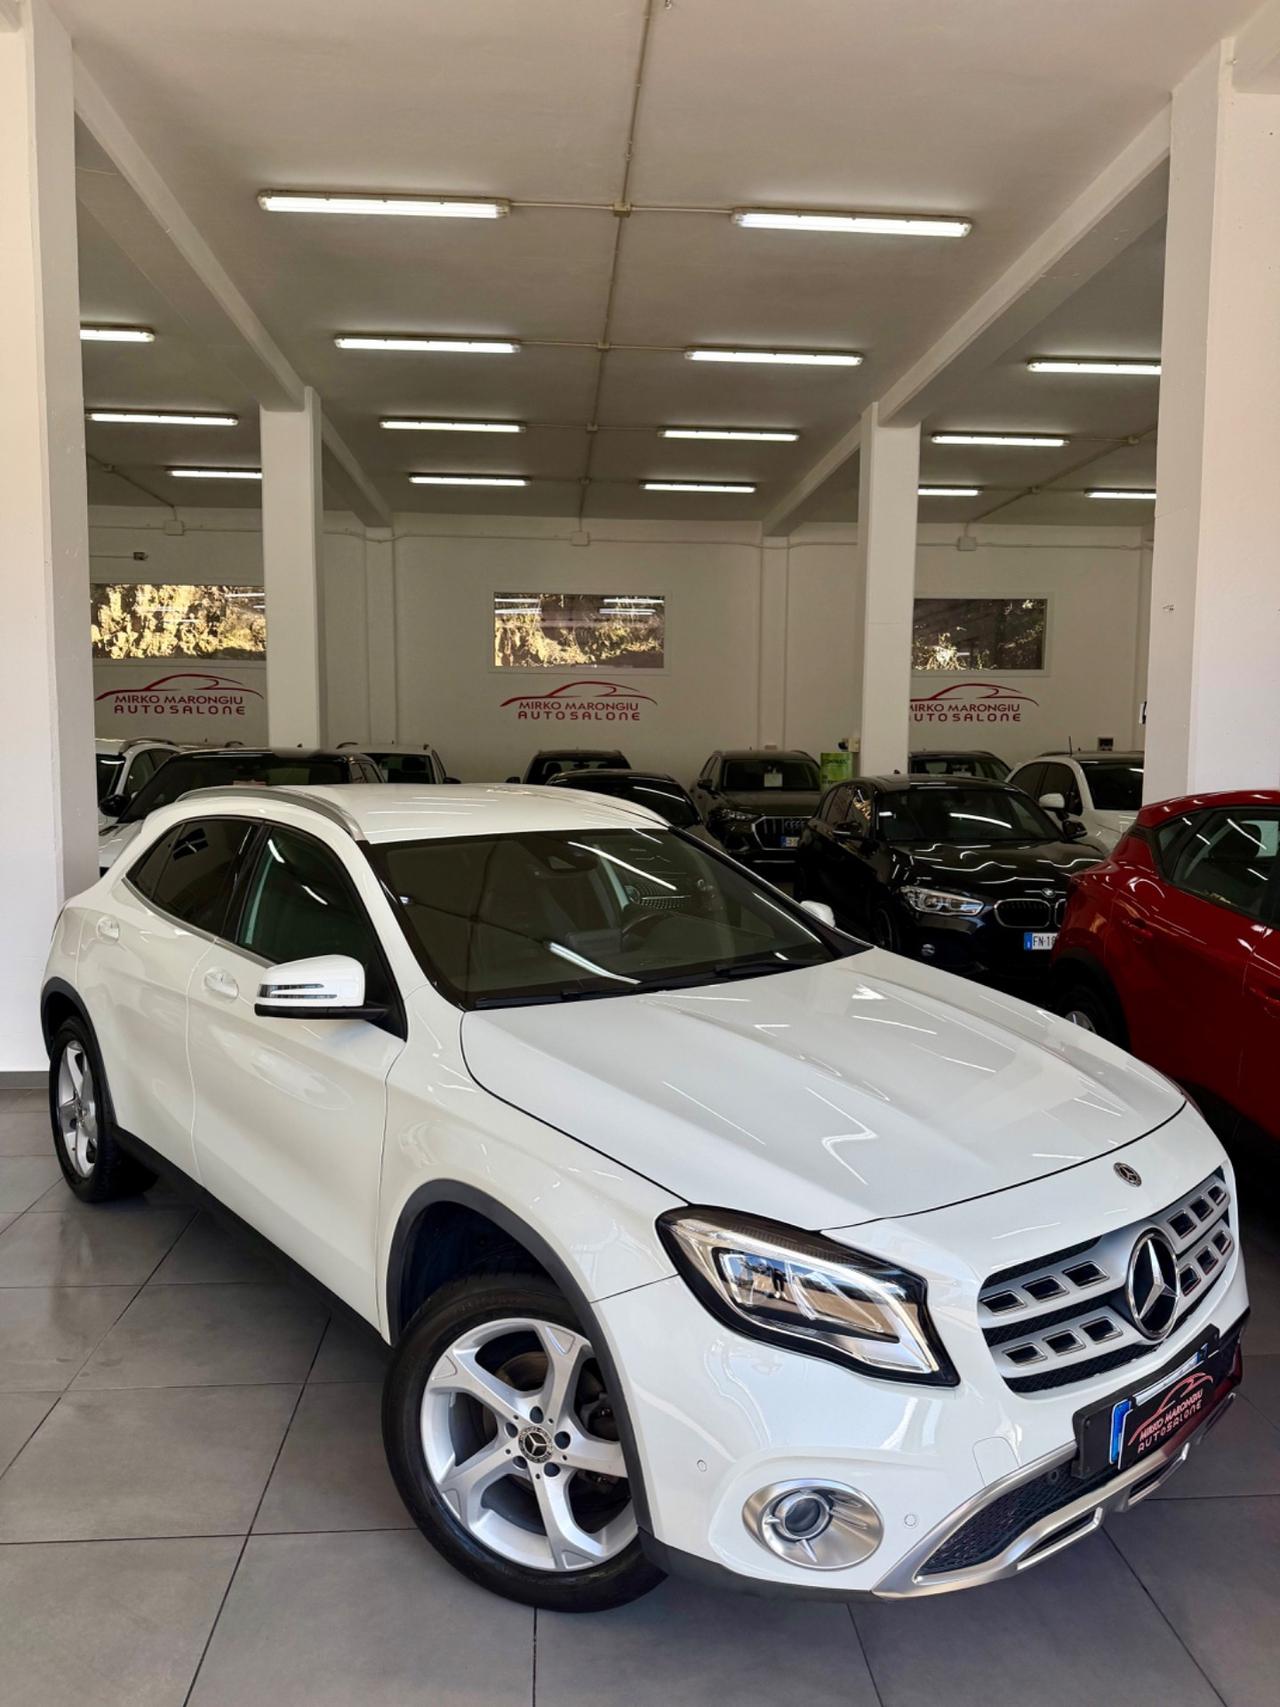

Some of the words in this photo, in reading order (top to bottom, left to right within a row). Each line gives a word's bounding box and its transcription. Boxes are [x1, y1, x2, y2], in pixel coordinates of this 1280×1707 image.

[115, 695, 160, 704] MIRKO
[164, 695, 243, 705] MARONGIU
[114, 705, 245, 715] AUTOSALONE
[519, 701, 561, 710] MIRKO
[565, 702, 639, 711] MARONGIU
[948, 704, 1020, 712] MARONGIU
[518, 711, 640, 721] AUTOSALONE
[911, 713, 1021, 722] UTOSALONE
